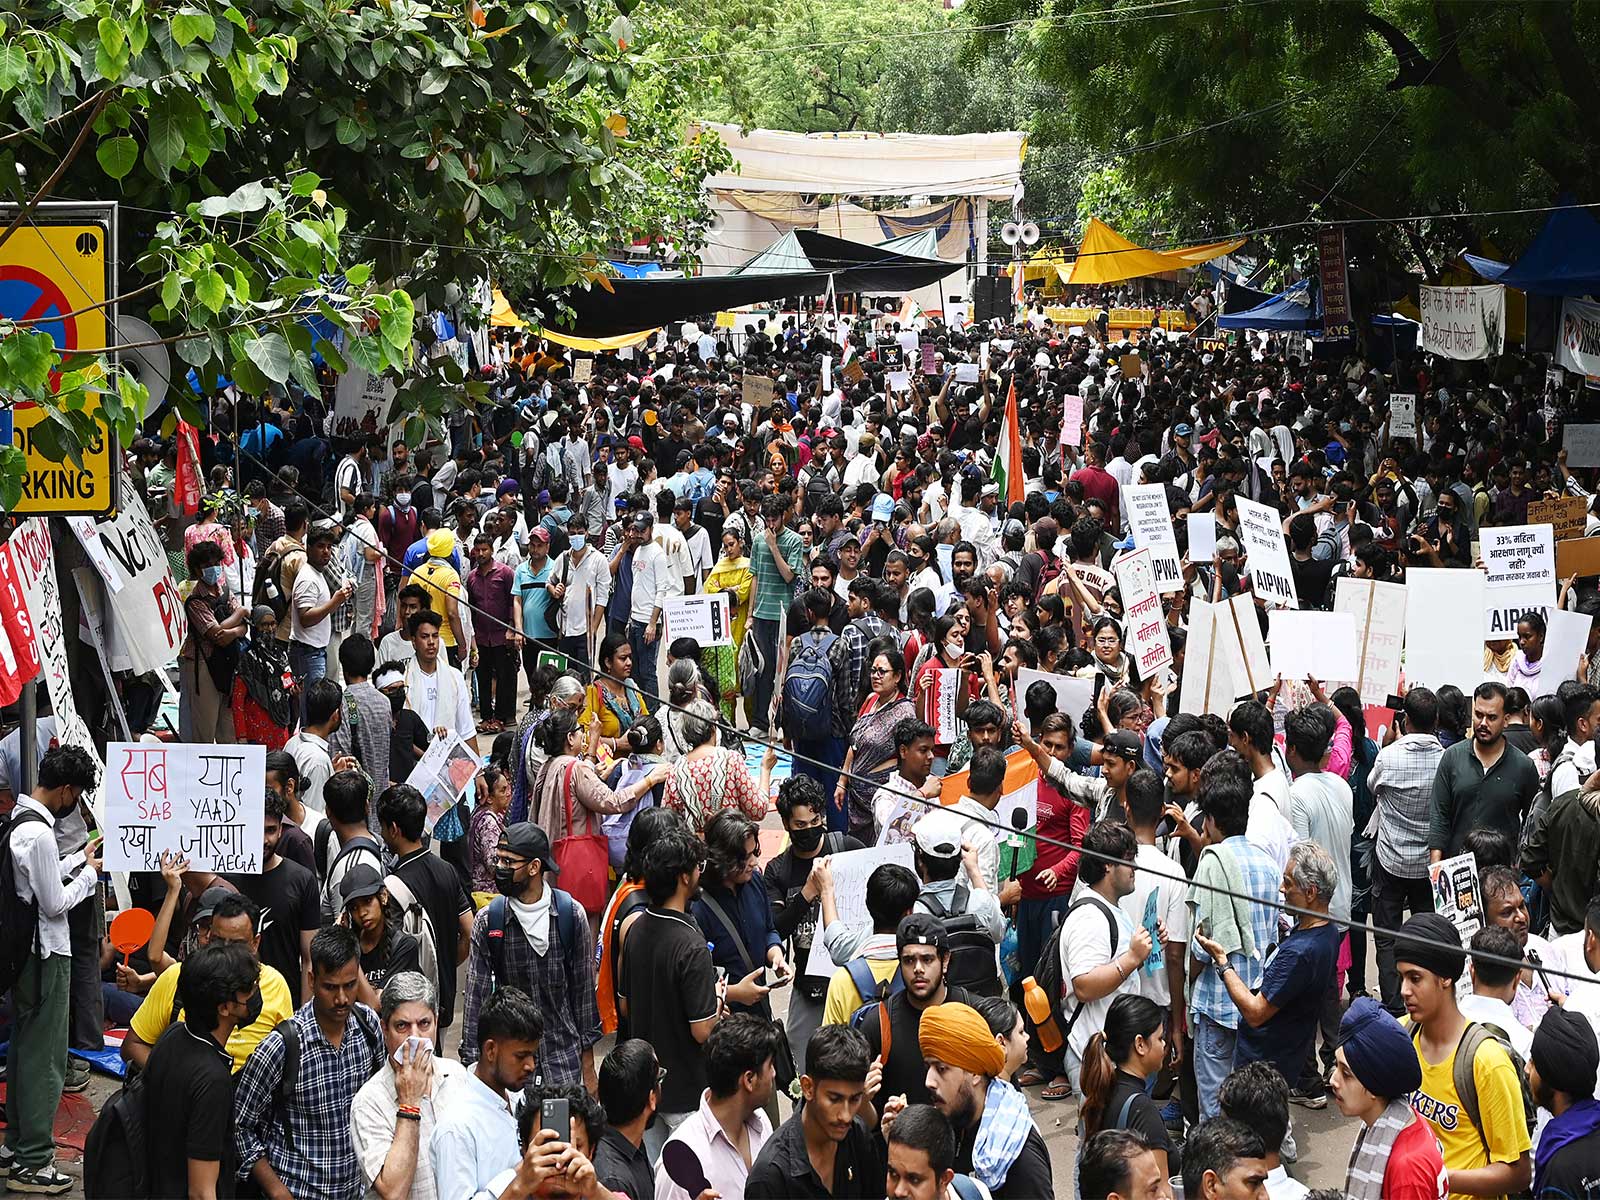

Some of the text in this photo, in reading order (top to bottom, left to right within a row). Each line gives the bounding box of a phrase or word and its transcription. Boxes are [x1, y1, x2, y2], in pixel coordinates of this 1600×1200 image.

[1326, 325, 1350, 337] KYS
[20, 469, 95, 499] RKING
[1513, 532, 1536, 544] महिला
[1490, 544, 1545, 559] आरक्षण लागू क्यों
[1086, 572, 1108, 589] ONLY
[1152, 558, 1180, 582] IPWA
[1487, 574, 1505, 582] भाजपा
[1506, 572, 1525, 581] सरकार
[1256, 569, 1293, 599] AIPWA
[1128, 591, 1159, 619] जनवादी
[1136, 620, 1161, 643] महिला
[1141, 643, 1167, 669] समिति
[121, 749, 245, 806] सब याद
[137, 798, 236, 823] SAB YAAD
[119, 824, 246, 858] रखा जाएगा
[211, 853, 257, 873] JAEGA
